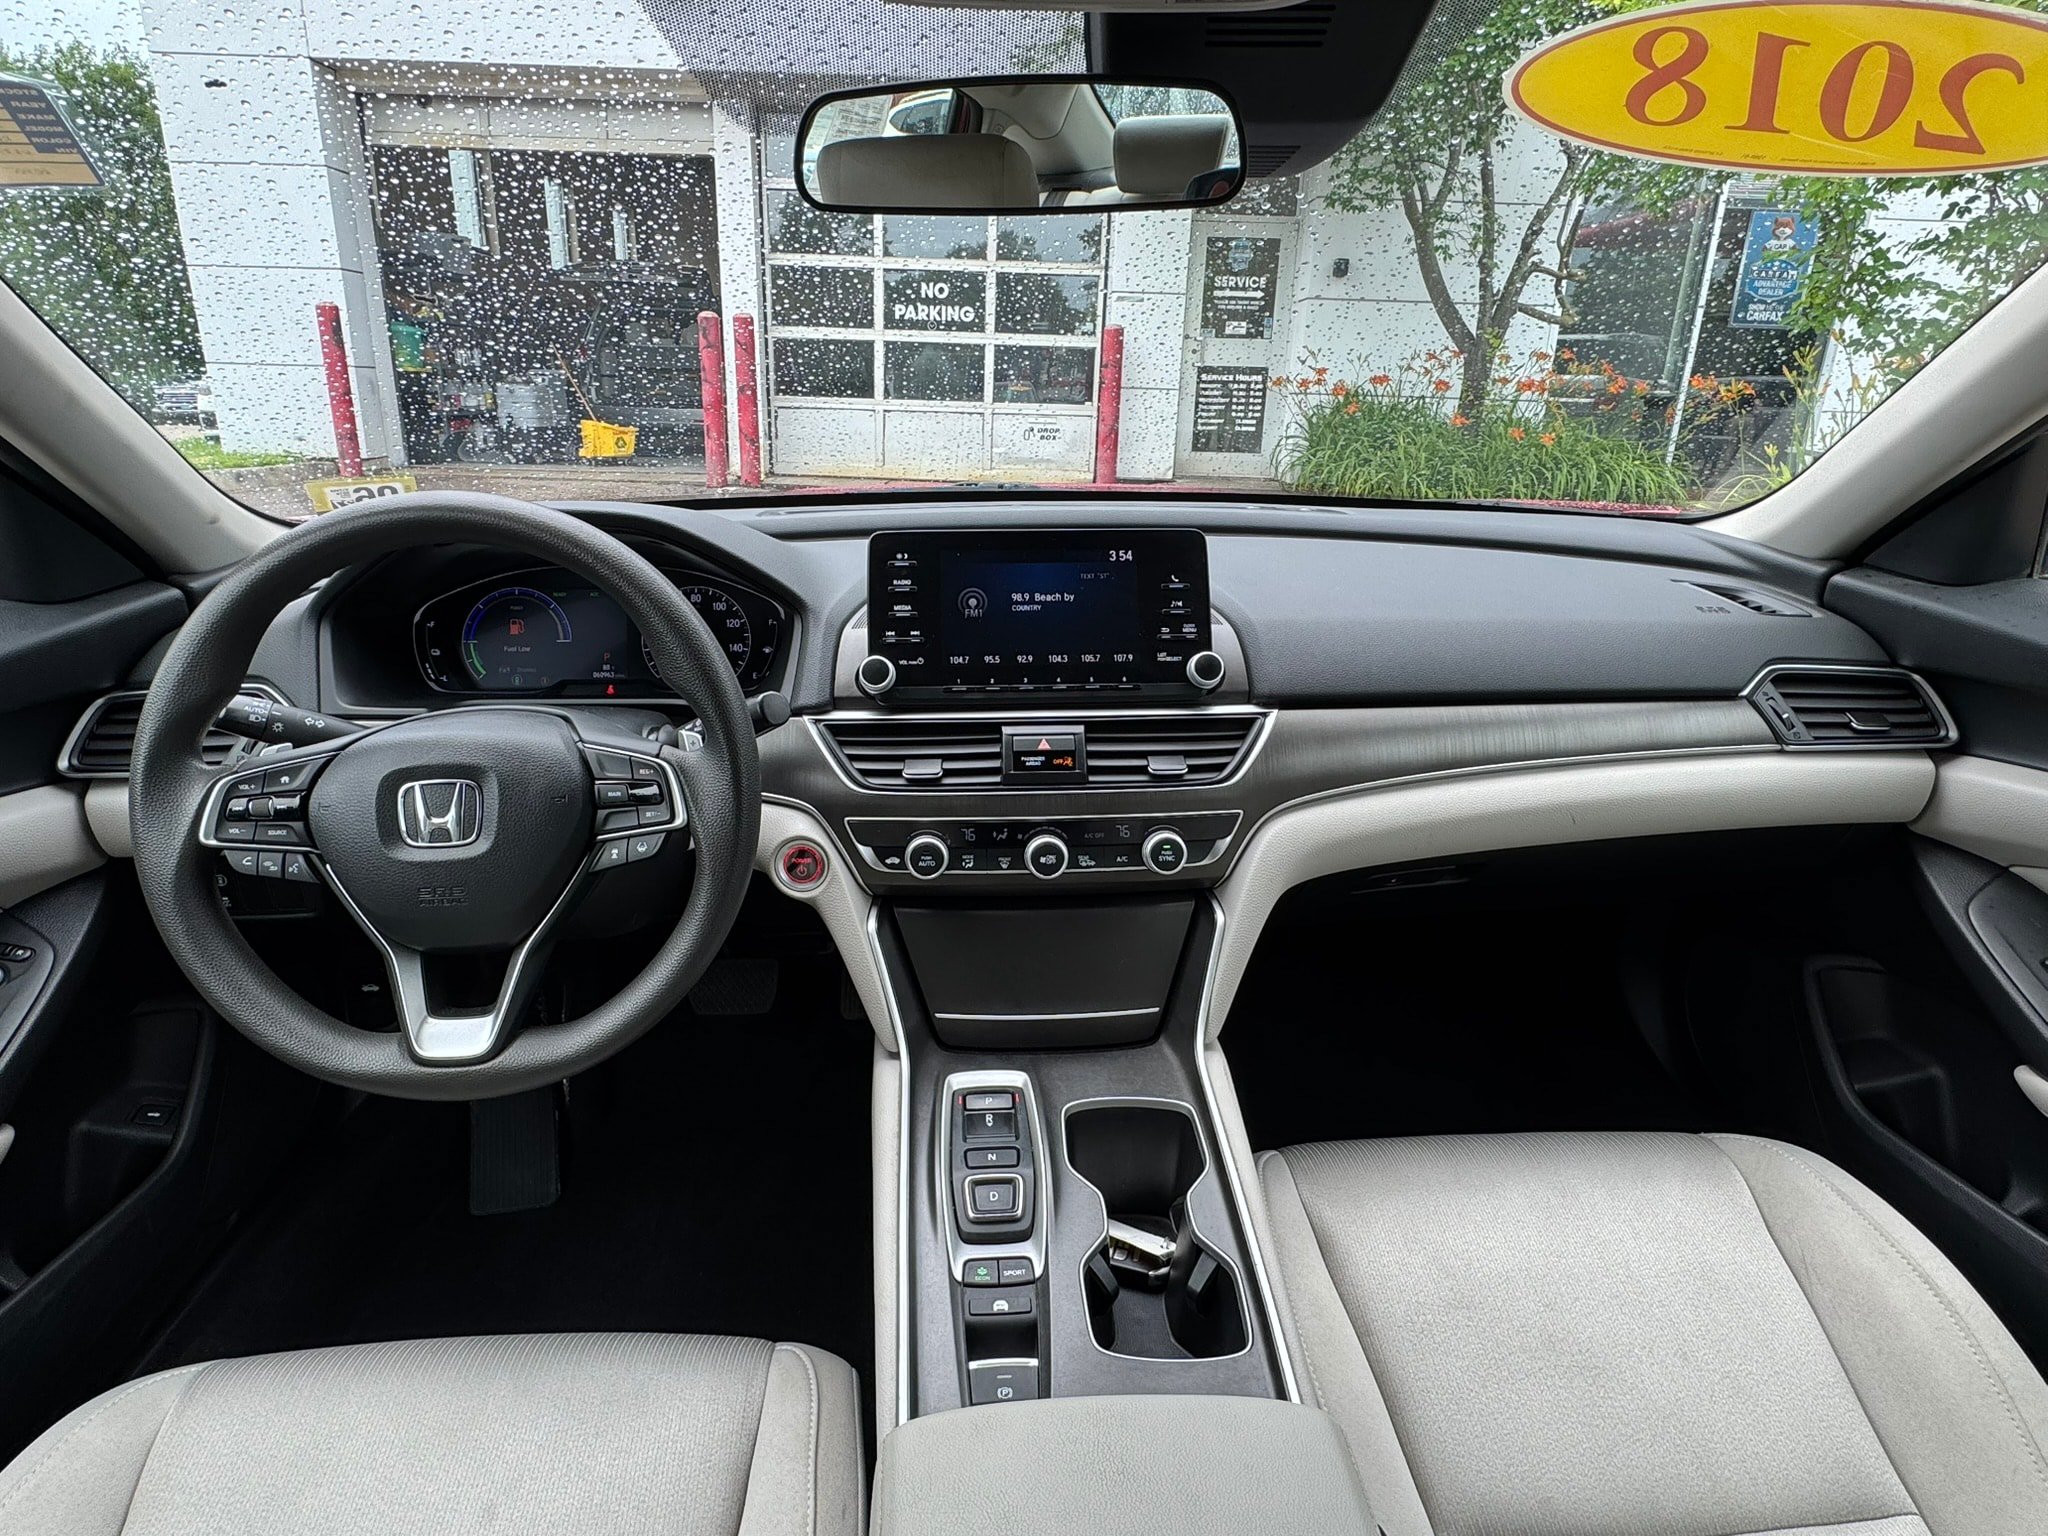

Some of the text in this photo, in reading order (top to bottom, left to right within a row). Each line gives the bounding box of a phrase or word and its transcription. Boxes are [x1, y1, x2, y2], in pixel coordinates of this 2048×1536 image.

[1213, 275, 1267, 288] SERVICE
[920, 282, 949, 299] NO
[894, 303, 975, 322] PARKING
[1746, 310, 1785, 321] CARFAX
[690, 593, 702, 602] 80
[1011, 592, 1075, 602] 98.9 Beach by
[712, 602, 727, 611] 100
[1011, 604, 1042, 612] COUNTRY
[964, 609, 983, 619] FM1
[726, 618, 740, 627] 120
[729, 643, 743, 652] 140
[949, 654, 1134, 664] 104.7 95.5 92.9 104.3 105.7 107.9
[244, 705, 264, 714] AUTO
[1158, 854, 1176, 862] SYNC
[985, 1097, 993, 1105] P
[987, 1153, 997, 1161] N
[990, 1191, 999, 1201] D
[1003, 1268, 1026, 1277] SPORT
